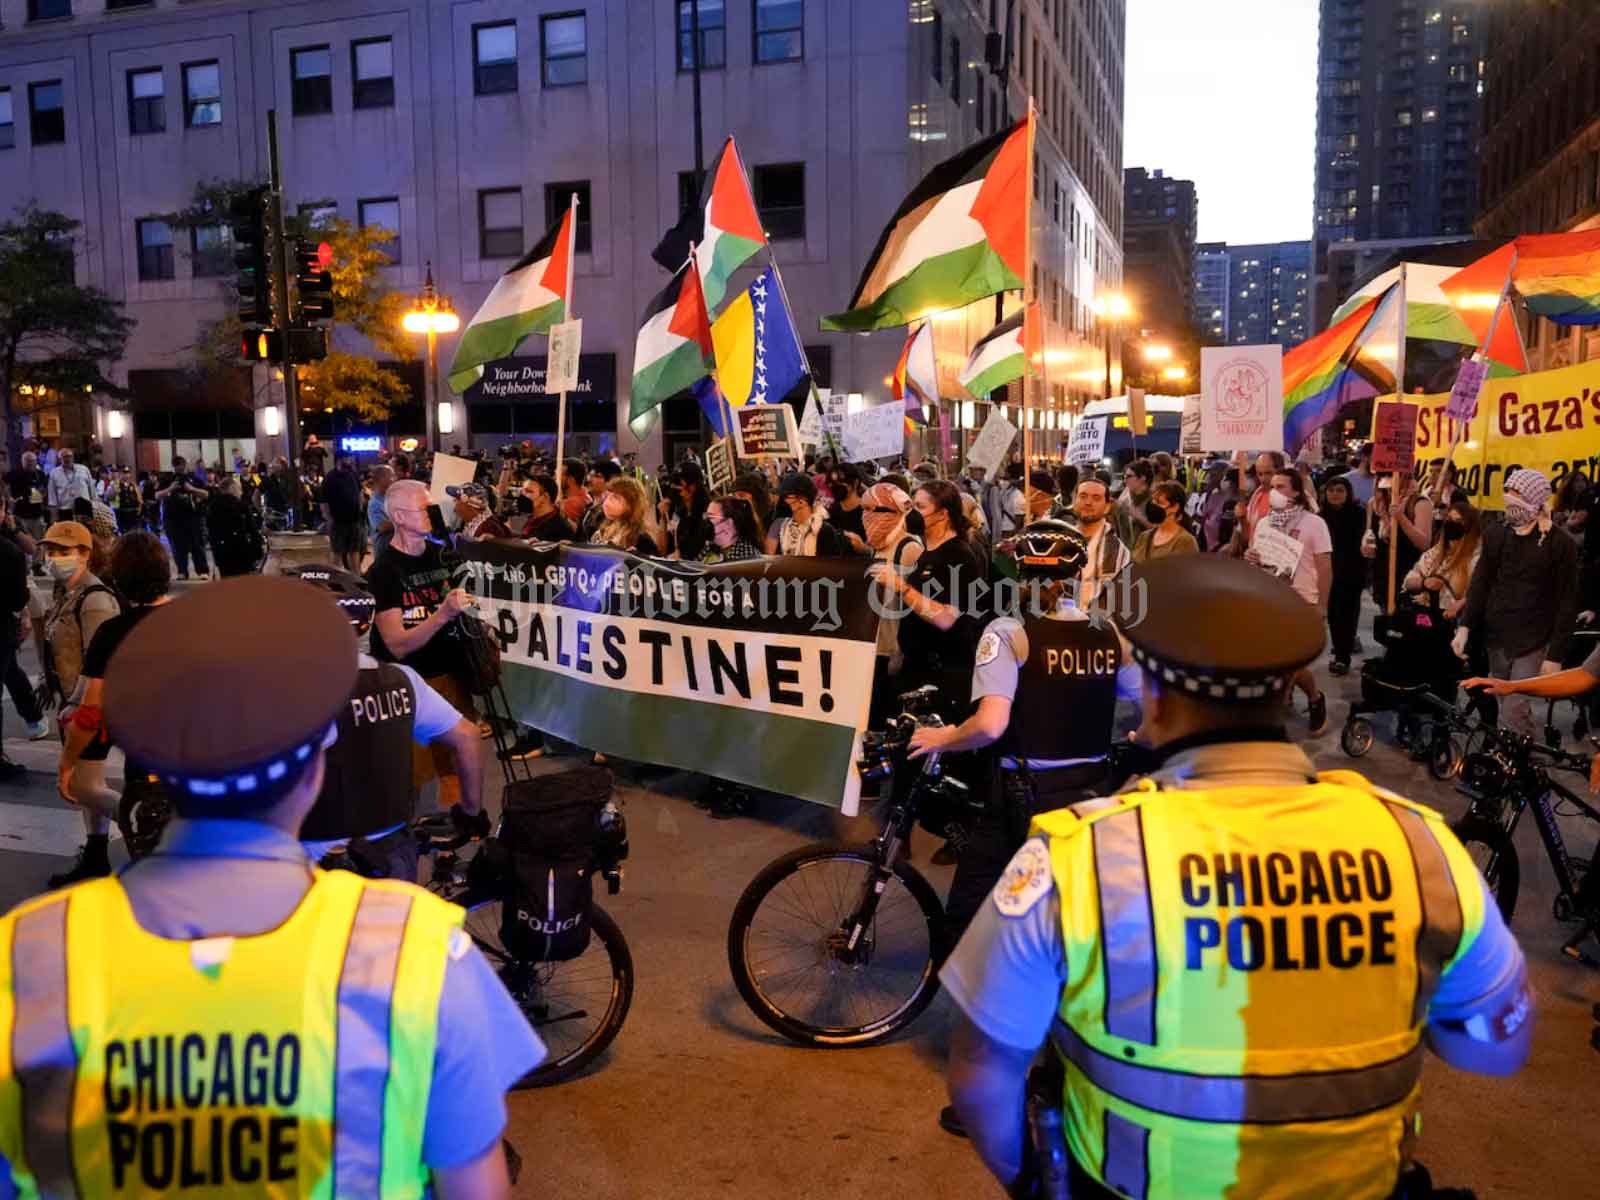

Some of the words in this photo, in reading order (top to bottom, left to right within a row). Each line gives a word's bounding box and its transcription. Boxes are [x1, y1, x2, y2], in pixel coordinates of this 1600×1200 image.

[482, 382, 546, 396] Neighborho
[577, 379, 593, 392] nk
[494, 367, 519, 380] Your
[522, 367, 546, 380] Dow
[300, 571, 331, 581] POLICE
[603, 571, 686, 602] PEOPLE
[697, 589, 734, 608] FOR
[742, 592, 754, 609] A
[498, 608, 835, 713] PALESTINE!
[1047, 649, 1116, 675] POLICE
[351, 687, 411, 727] POLICE
[1179, 849, 1393, 907] CHICAGO
[1185, 910, 1396, 972] POLICE
[104, 1031, 301, 1115] CHICAGO
[107, 1115, 299, 1191] POLICE
